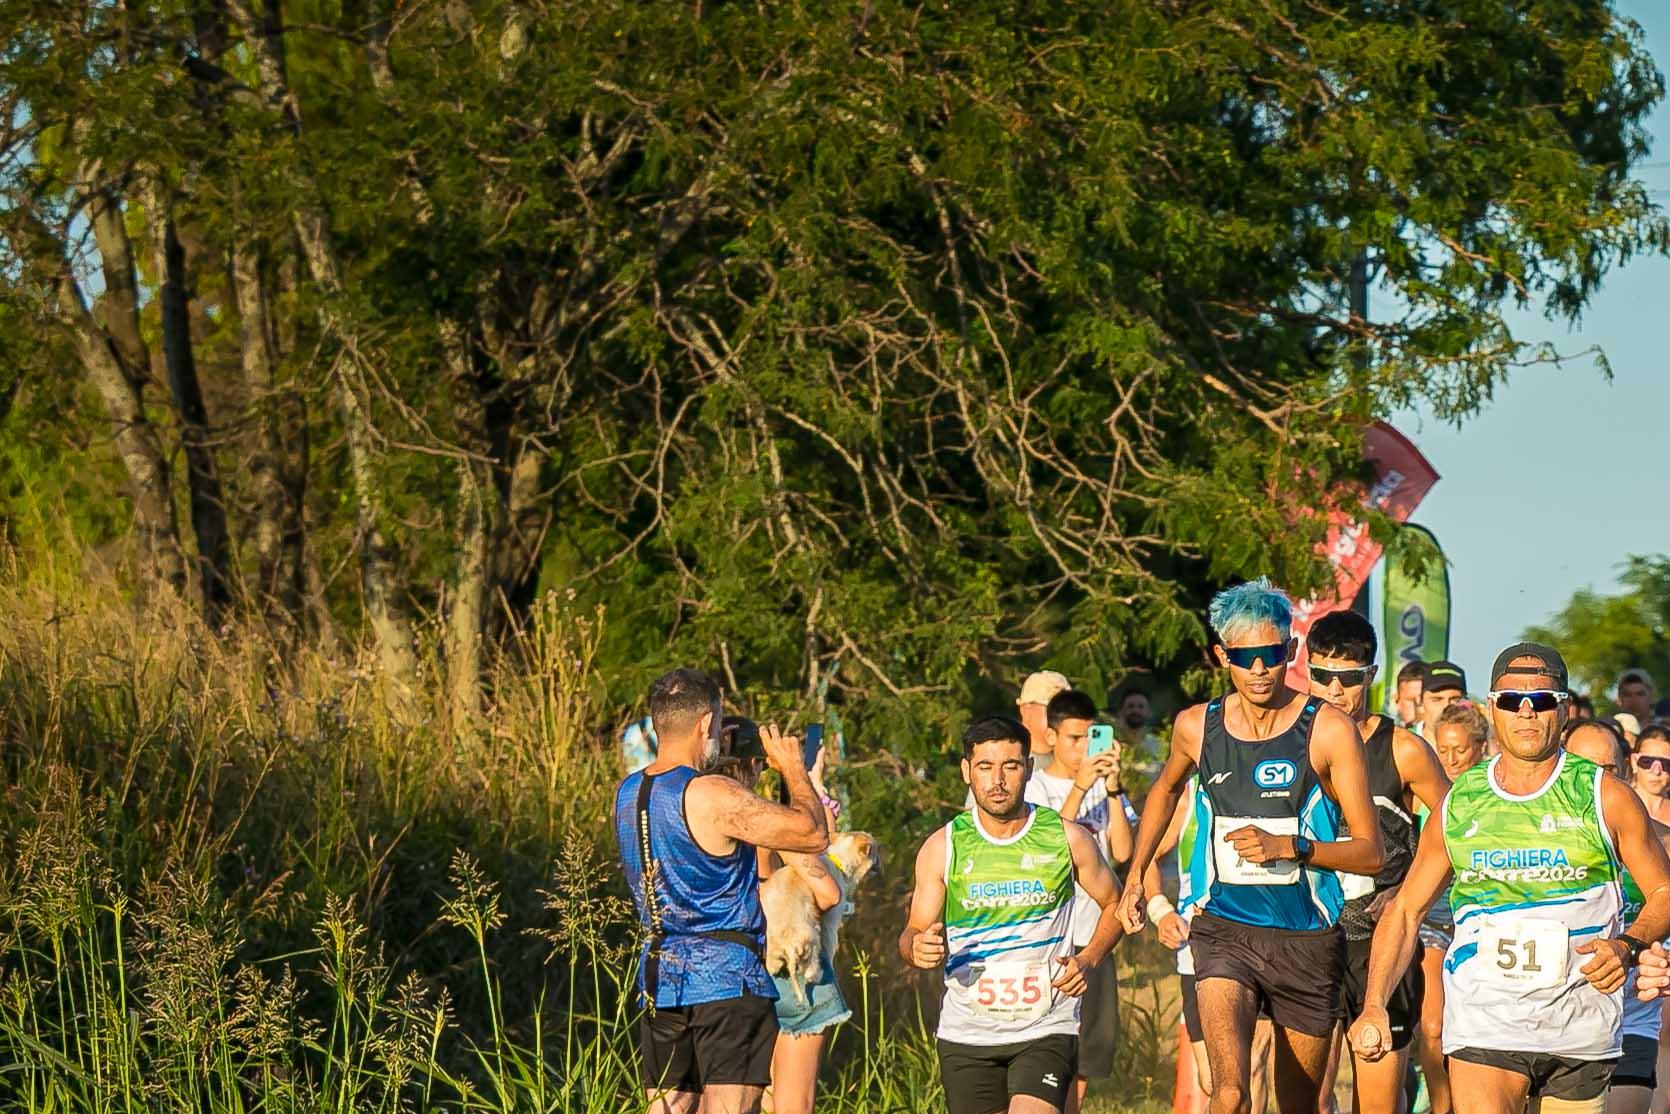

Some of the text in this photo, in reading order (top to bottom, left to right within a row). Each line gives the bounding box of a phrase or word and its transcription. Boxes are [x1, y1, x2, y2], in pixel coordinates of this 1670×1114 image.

[1472, 848, 1569, 869] FIGHIERA
[969, 880, 1044, 898] FIGHIERA
[1496, 938, 1542, 972] 51
[977, 976, 1041, 1005] 535
